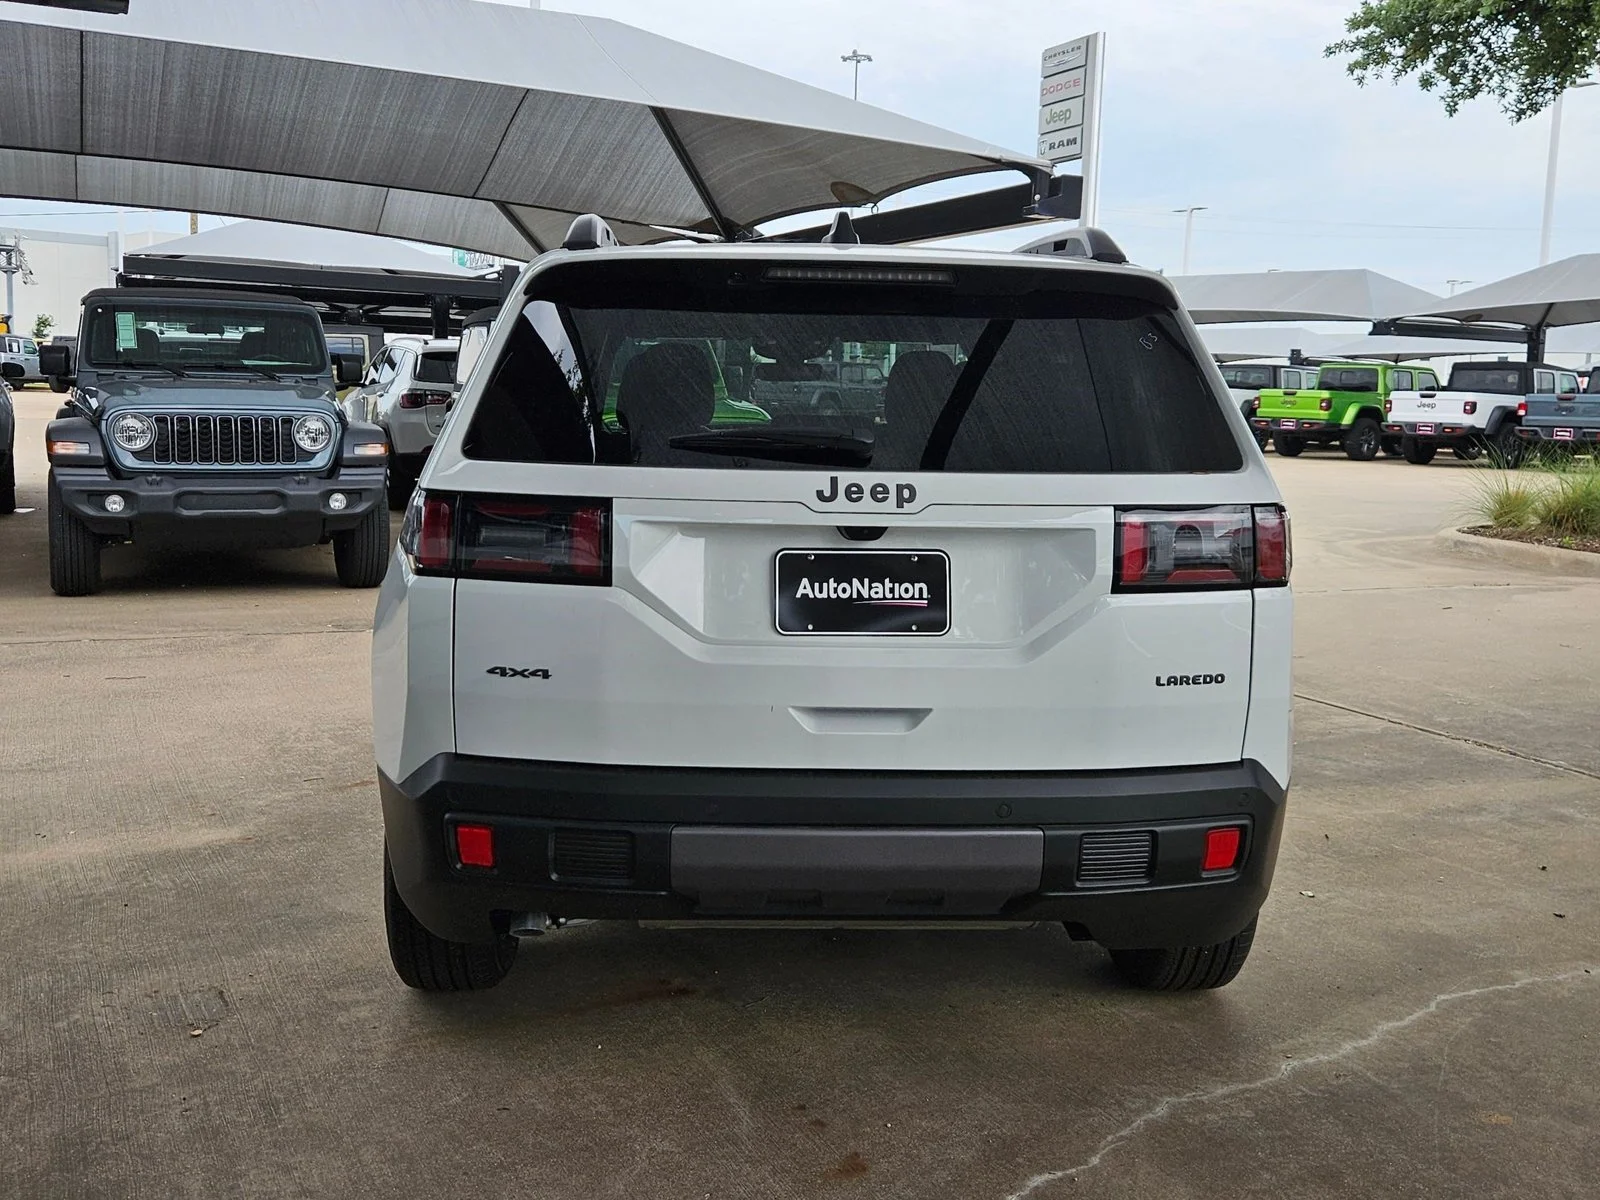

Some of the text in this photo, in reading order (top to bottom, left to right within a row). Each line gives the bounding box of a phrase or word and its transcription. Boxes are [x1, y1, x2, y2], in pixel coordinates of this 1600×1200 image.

[1044, 45, 1082, 61] CHRYSLER
[1042, 78, 1081, 96] DODGE
[1045, 108, 1072, 124] Jeep
[1048, 137, 1078, 151] RAM
[1416, 400, 1437, 409] Jeep
[815, 476, 917, 508] Jeep
[795, 577, 931, 599] AutoNation
[1155, 673, 1226, 687] LAREDO
